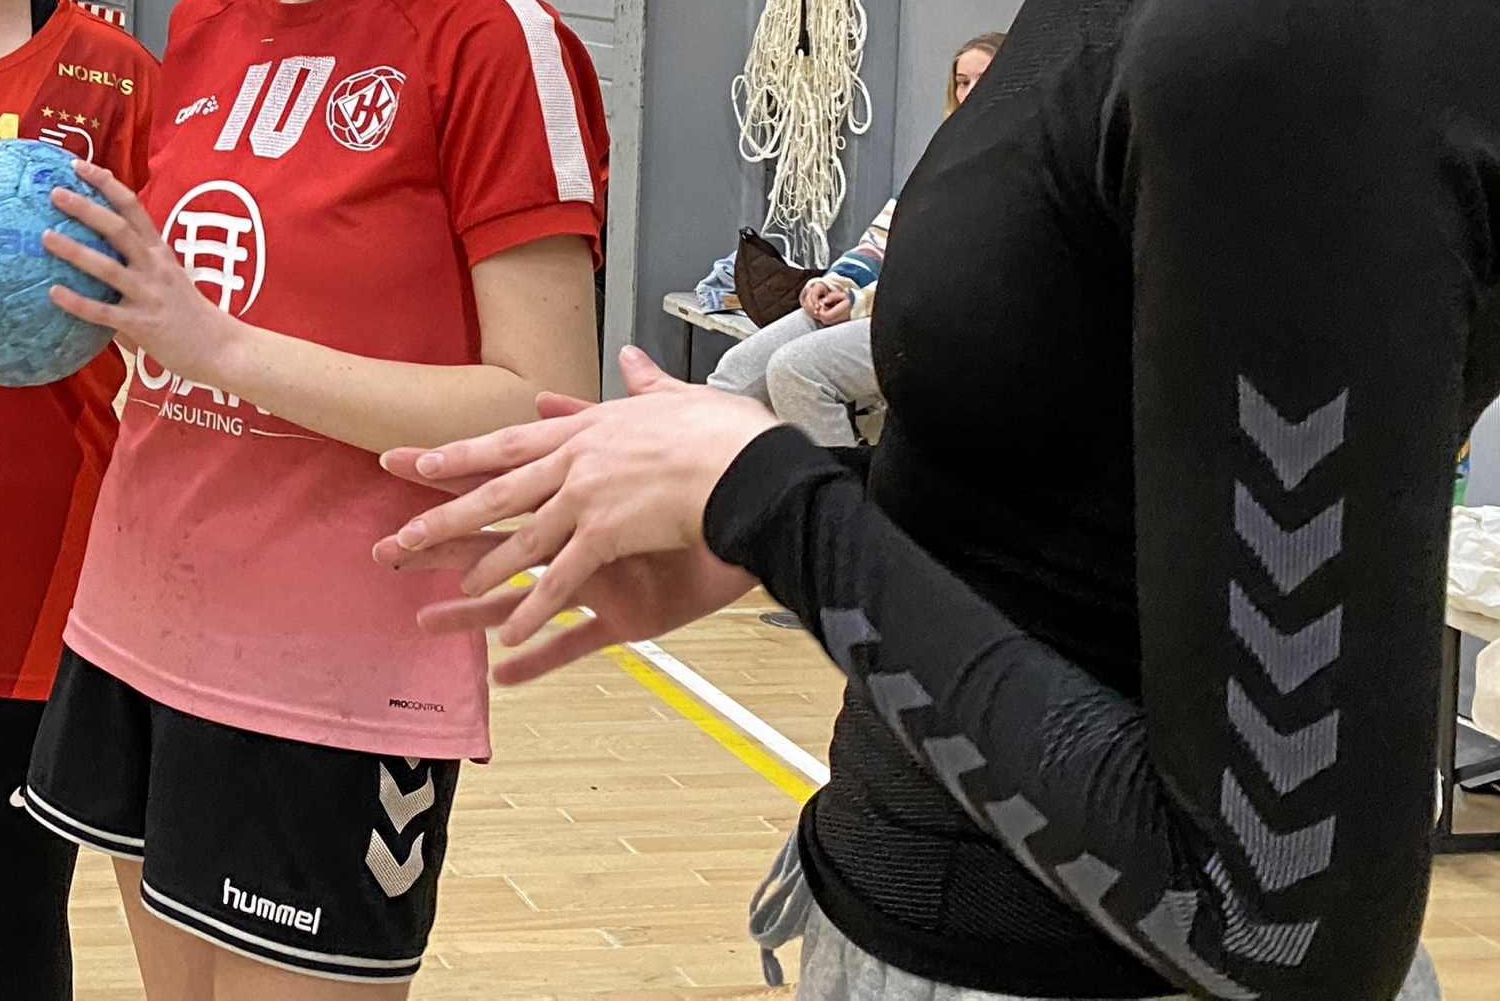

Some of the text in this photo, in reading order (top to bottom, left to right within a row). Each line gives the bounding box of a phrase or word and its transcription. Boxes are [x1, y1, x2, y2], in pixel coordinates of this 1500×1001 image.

[58, 62, 135, 95] NORLYS
[213, 56, 336, 158] 10
[160, 400, 243, 436] NSULTING
[223, 878, 321, 935] hummel
